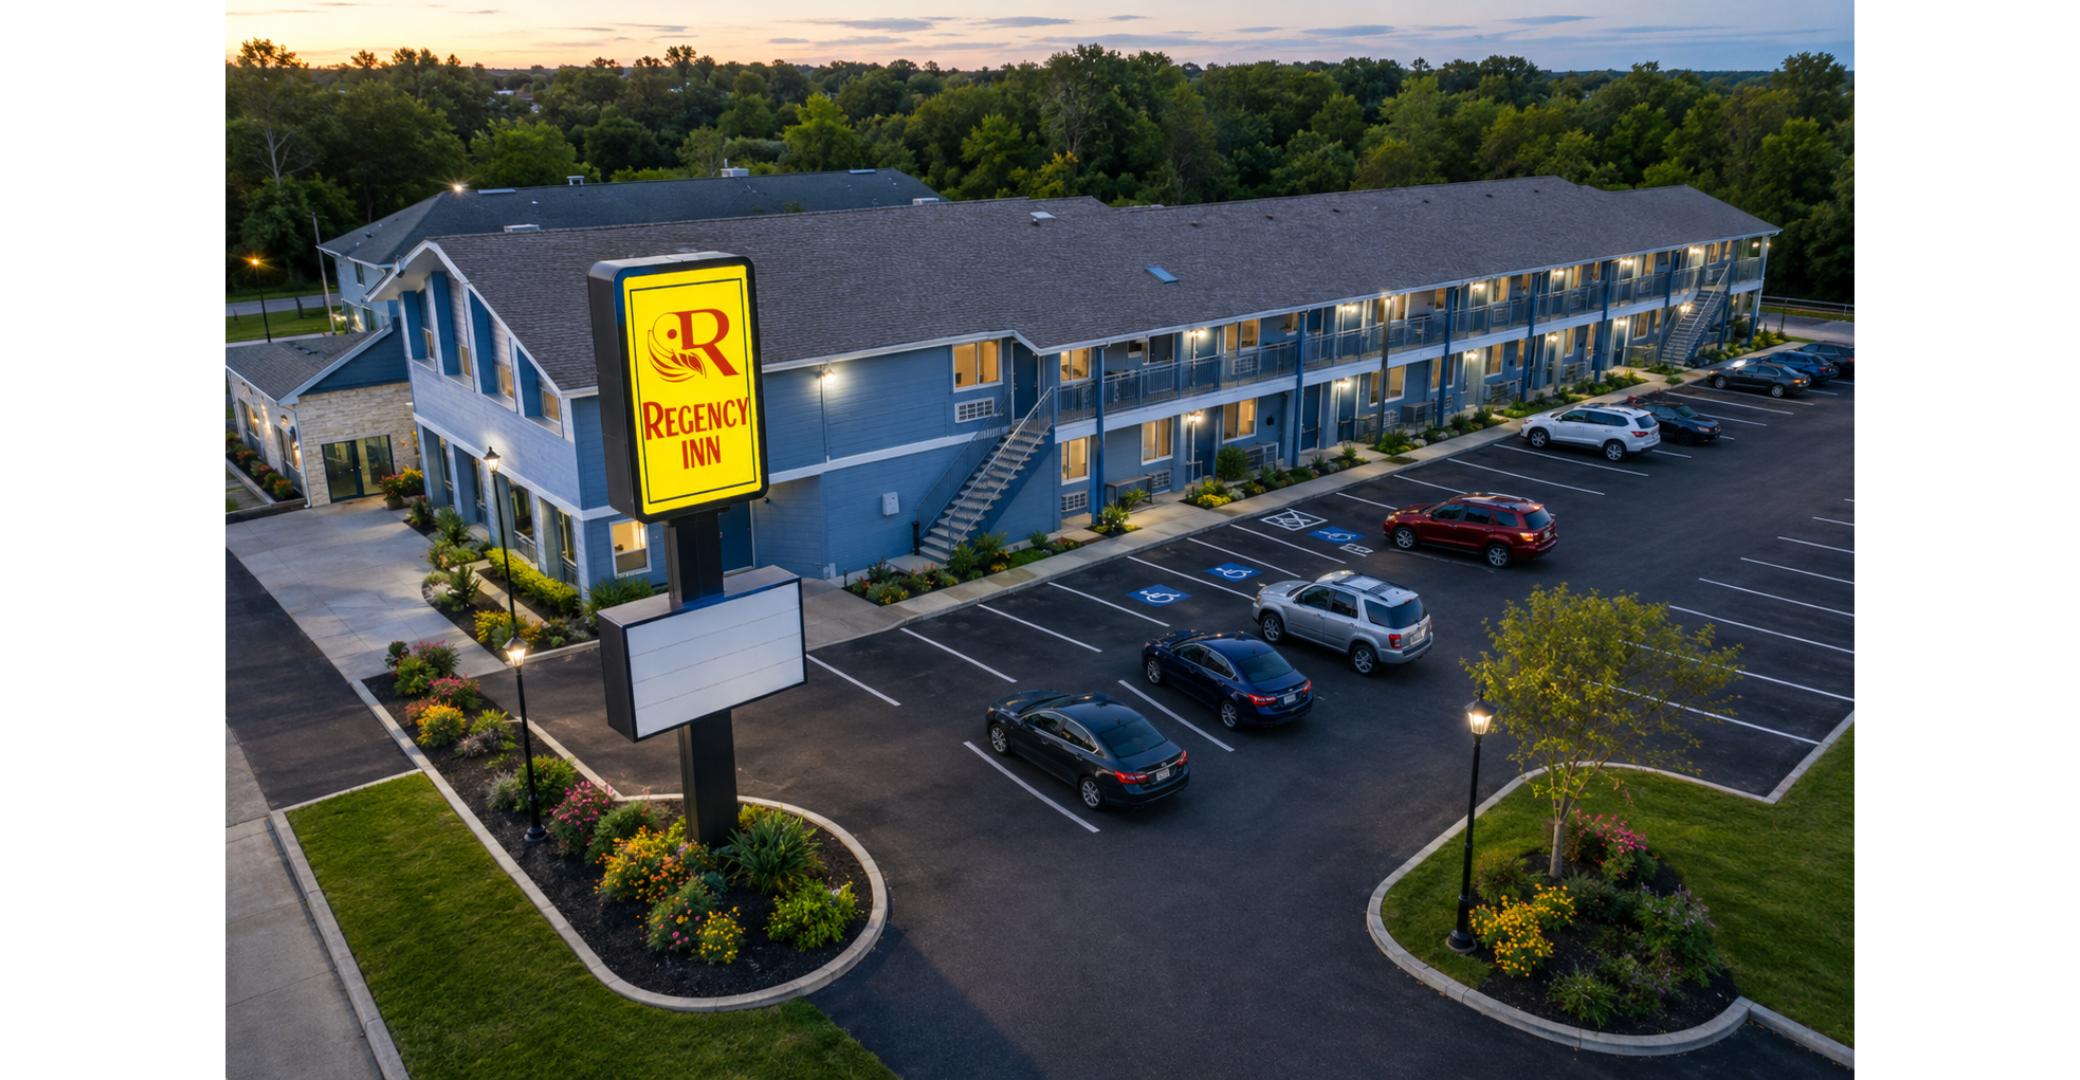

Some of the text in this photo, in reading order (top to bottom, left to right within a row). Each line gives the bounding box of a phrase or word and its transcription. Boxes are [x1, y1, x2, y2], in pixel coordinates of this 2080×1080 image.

[672, 308, 739, 376] R
[643, 397, 749, 440] REGENCY
[682, 435, 721, 470] INN
